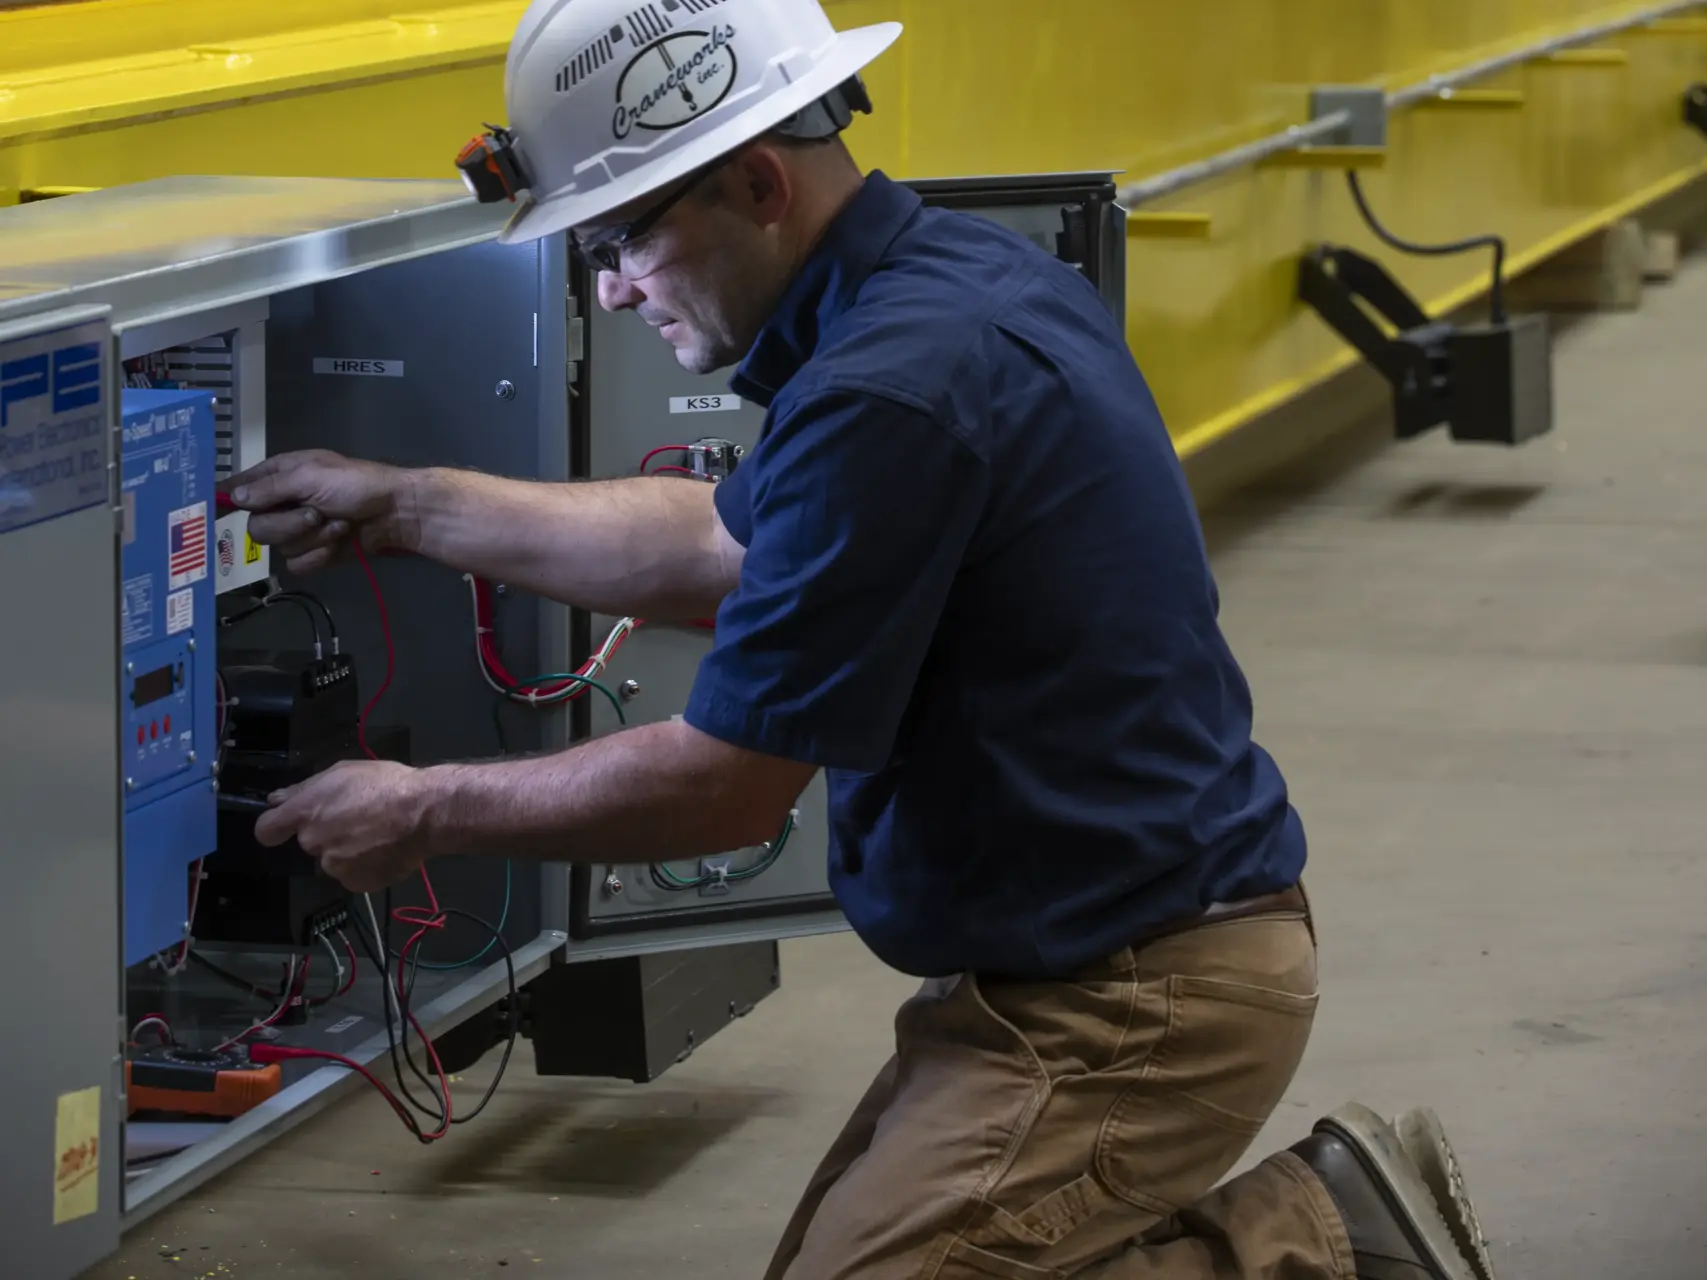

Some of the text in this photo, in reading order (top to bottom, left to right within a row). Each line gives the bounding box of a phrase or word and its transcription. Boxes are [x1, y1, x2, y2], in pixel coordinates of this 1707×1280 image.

[612, 24, 736, 140] Craneworks
[333, 360, 386, 374] HRES
[687, 396, 722, 410] KS3
